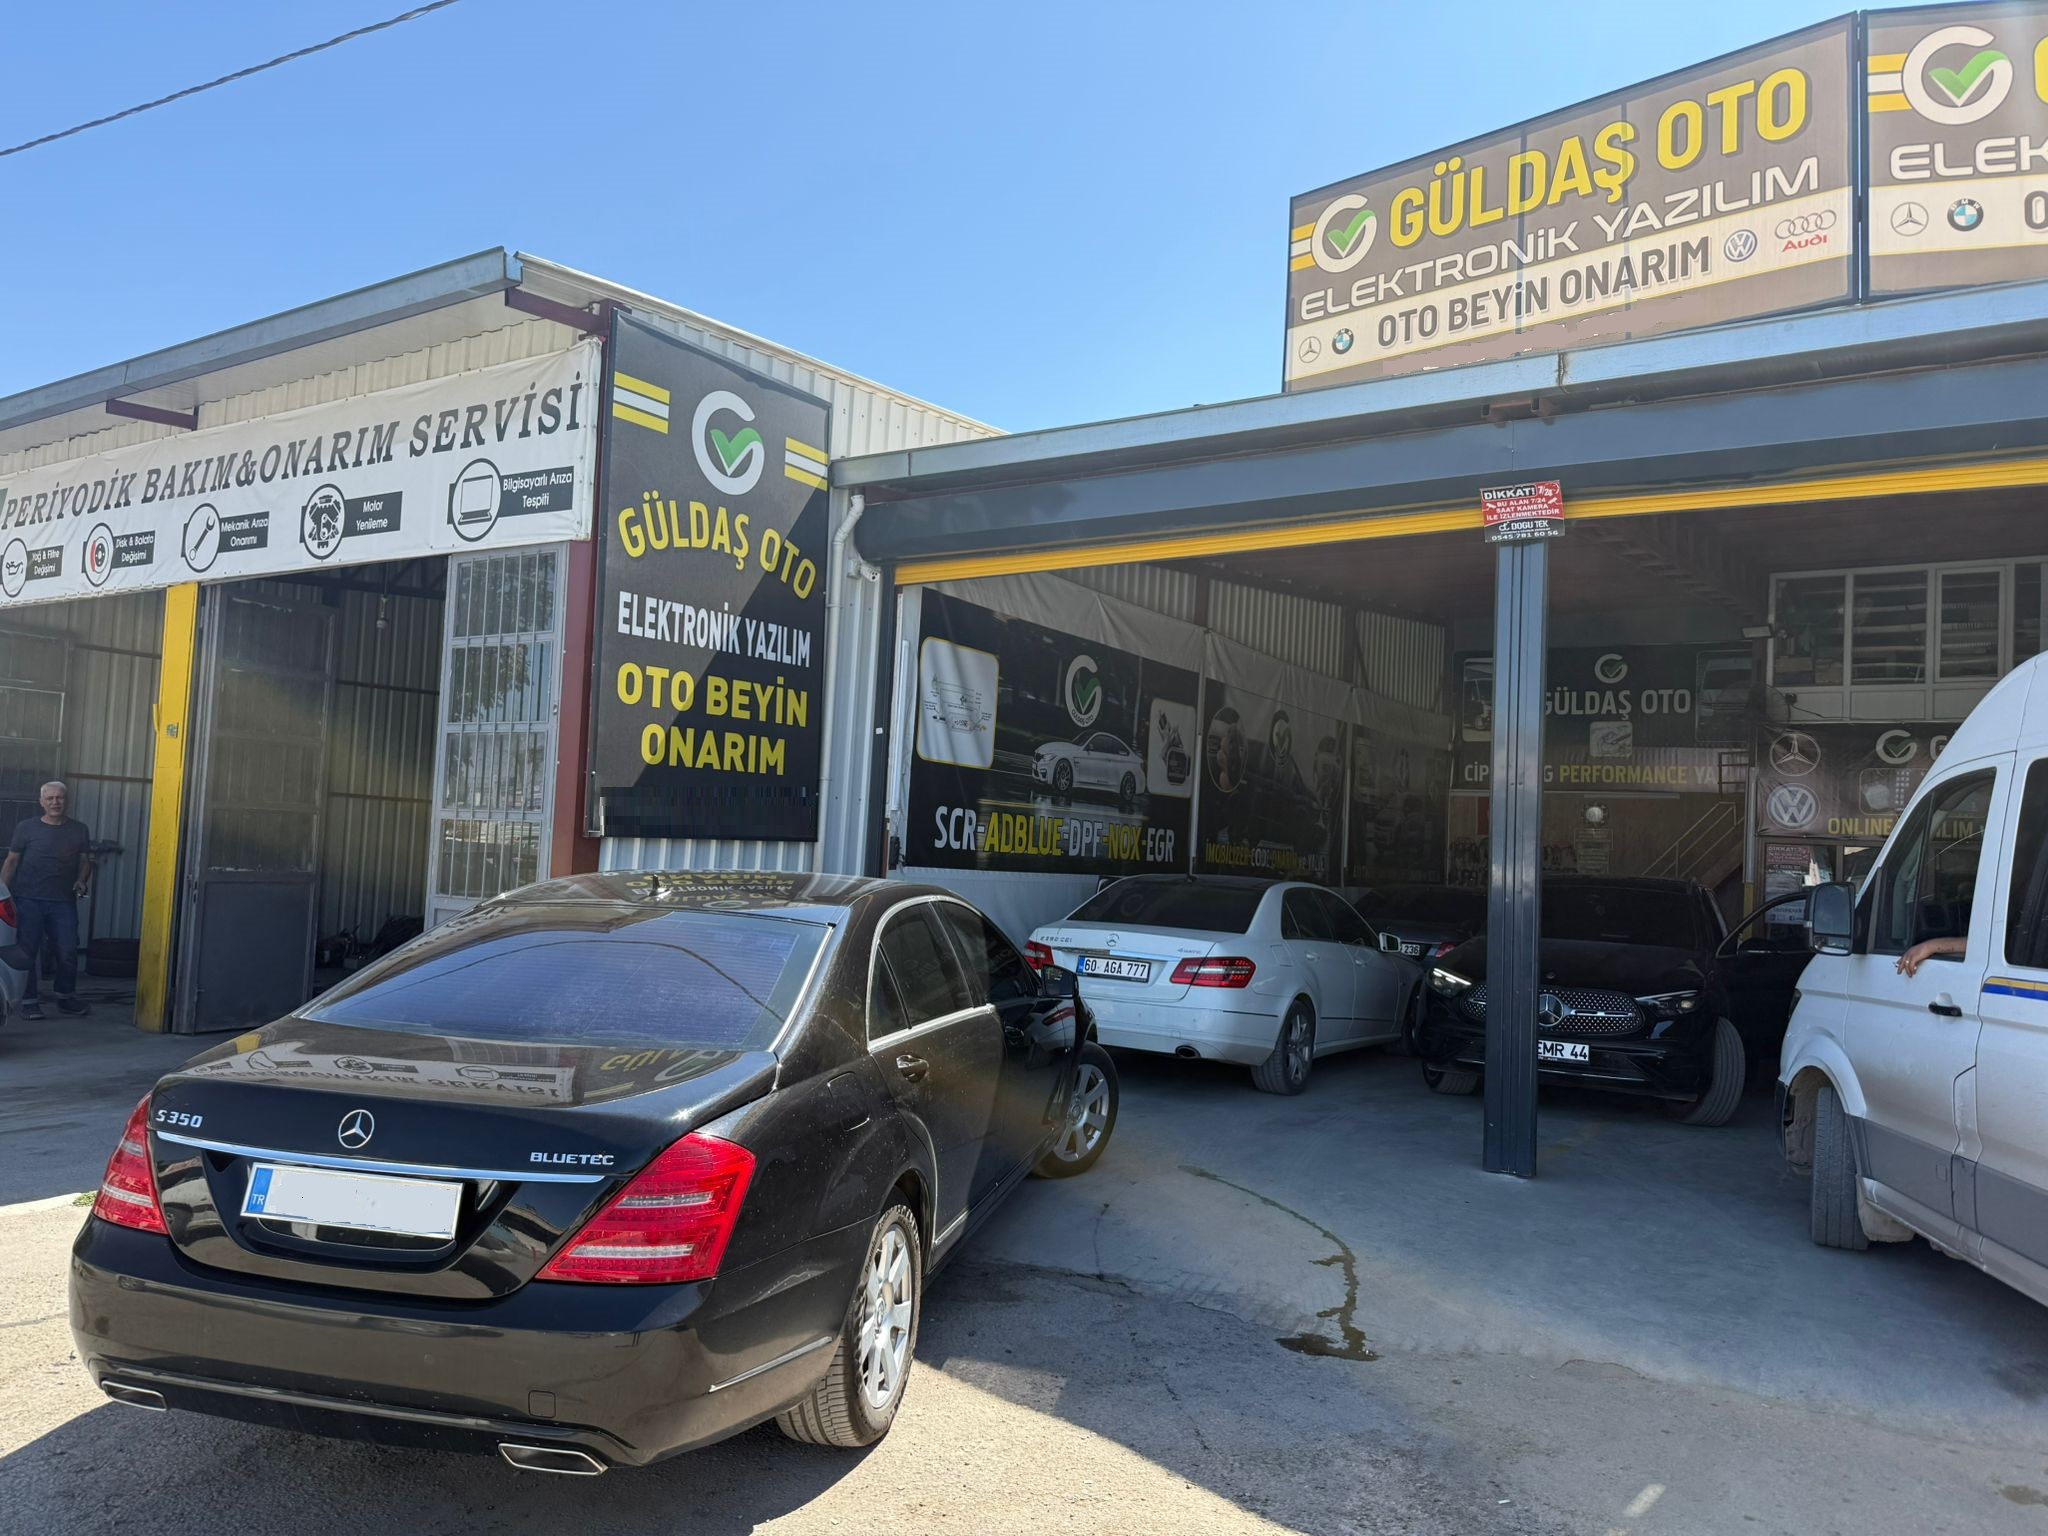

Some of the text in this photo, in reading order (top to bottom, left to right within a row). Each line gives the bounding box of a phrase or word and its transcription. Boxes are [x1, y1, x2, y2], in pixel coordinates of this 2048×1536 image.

[1388, 67, 1806, 247] GÜLDAŞ OTO
[1593, 156, 1818, 243] YAZILIM
[1782, 234, 1828, 253] Audi
[1378, 305, 1438, 347] OTO
[1559, 236, 1710, 305] ONARIM
[2, 370, 583, 531] PERİYODİK BAKIM&ONARIM SERVİSİ
[503, 472, 573, 494] Bilgisayarlı Arıza
[363, 500, 384, 513] Motor
[522, 492, 550, 509] Tespiti
[1509, 499, 1529, 507] ALAN
[1517, 503, 1549, 511] KAMERA
[221, 517, 269, 532] Mekanik Arıza
[356, 517, 388, 531] Yenileme
[115, 538, 128, 549] Disk
[134, 534, 154, 546] Balata
[618, 490, 818, 600] GÜLDAŞ OTO
[617, 590, 812, 668] ELEKTRONİK YAZILIM
[616, 662, 808, 728] OTO BEYİN
[1640, 689, 1691, 714] OTO
[640, 722, 786, 776] ONARIM
[1559, 764, 1687, 784] PERFORMANCE
[1828, 817, 1891, 835] ONLINE
[1084, 959, 1097, 972] 60
[1104, 960, 1122, 975] AGA
[1127, 963, 1146, 977] 777
[1570, 1045, 1588, 1060] 44
[155, 1109, 203, 1129] S350
[530, 1151, 614, 1166] BLUETEC
[252, 1193, 265, 1206] TR
